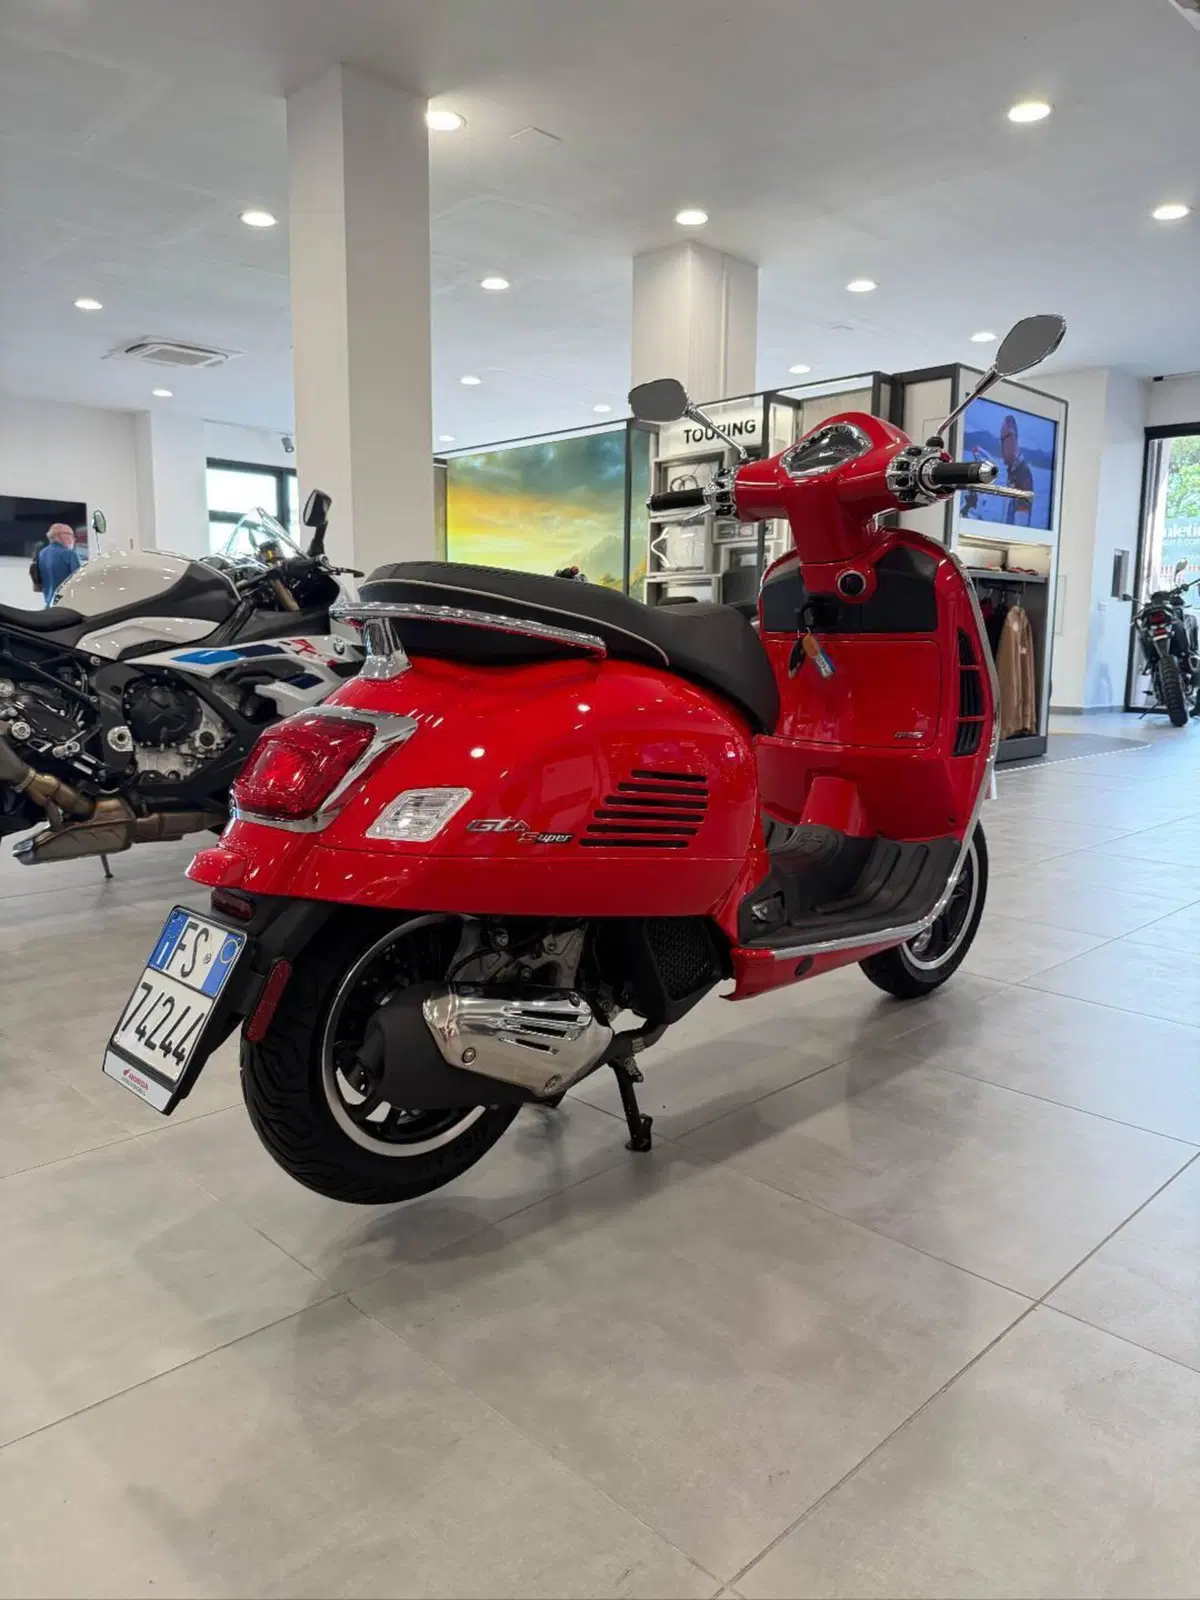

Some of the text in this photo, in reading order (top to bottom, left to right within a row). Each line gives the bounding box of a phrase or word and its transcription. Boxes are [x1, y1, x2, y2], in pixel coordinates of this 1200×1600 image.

[684, 420, 756, 444] TOURING
[166, 920, 210, 978] FS
[121, 982, 205, 1067] 74244
[128, 1073, 149, 1091] HONDA
